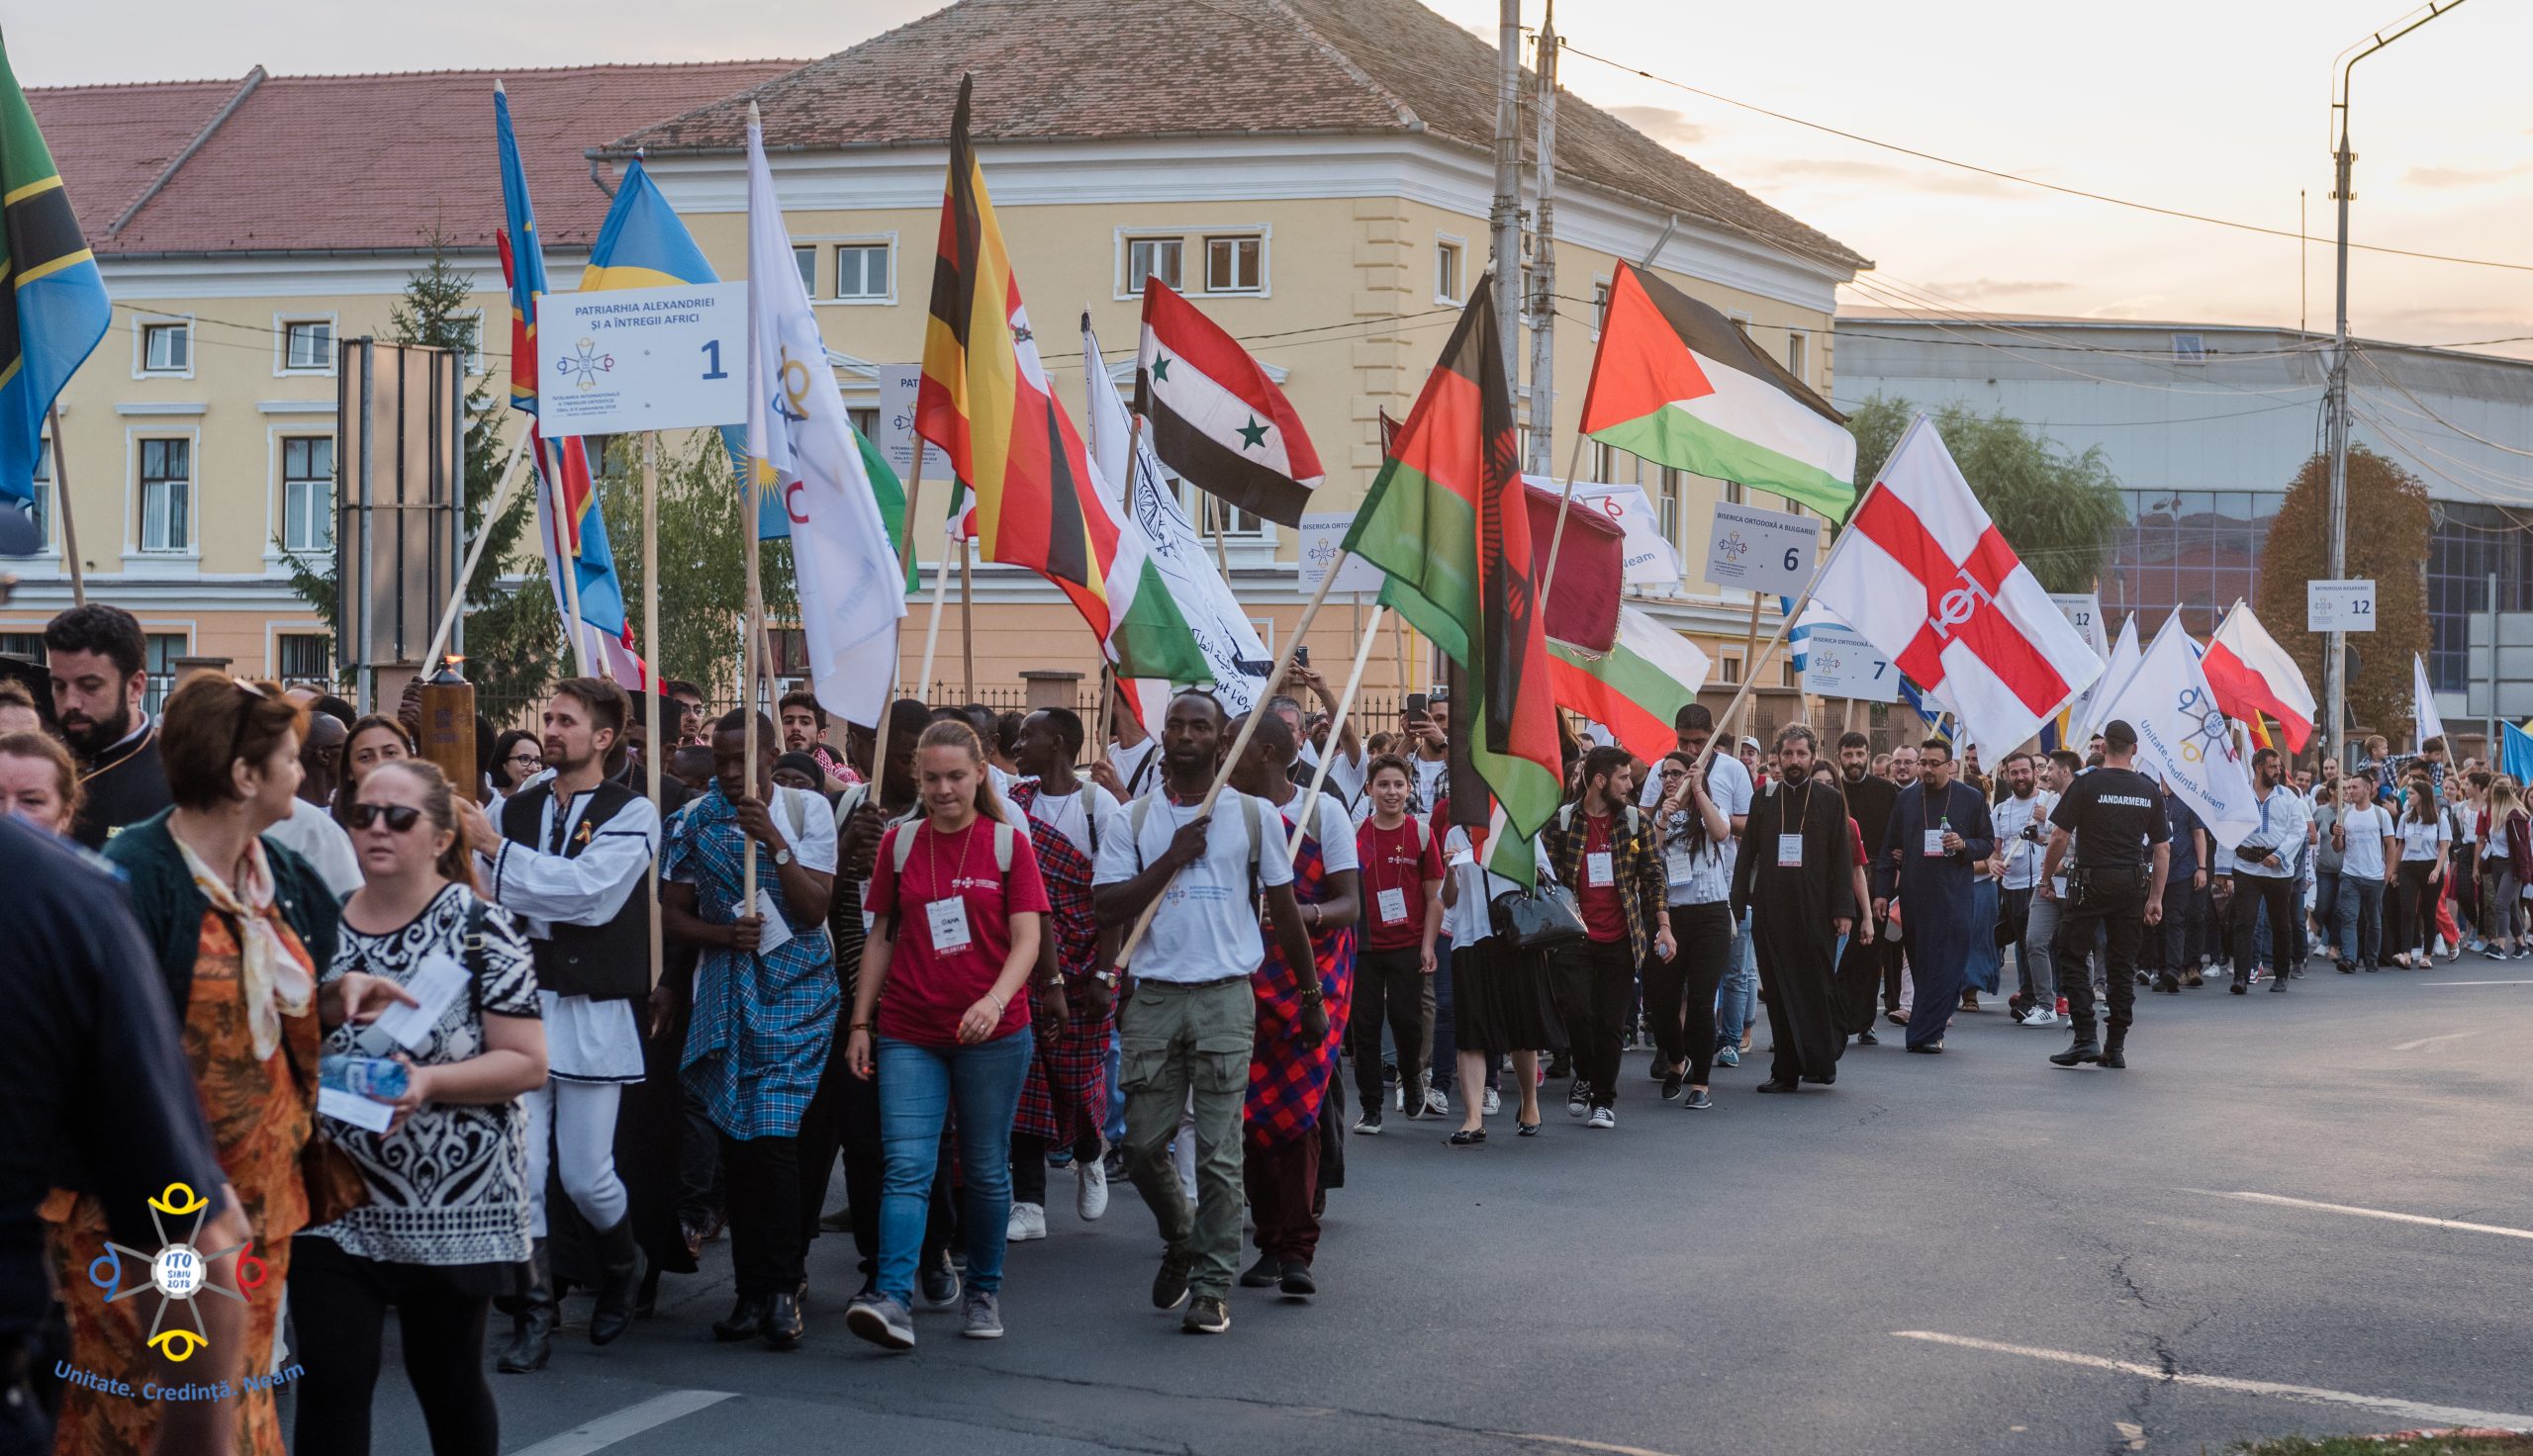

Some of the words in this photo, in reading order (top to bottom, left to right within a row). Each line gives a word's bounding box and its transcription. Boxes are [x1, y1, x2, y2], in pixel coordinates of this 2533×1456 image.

[575, 303, 640, 316] PATRIARHIA
[642, 298, 714, 312] ALEXANDRIEI
[604, 318, 611, 328] A
[613, 316, 661, 327] ÎNTREGII
[664, 314, 700, 324] AFRICI
[701, 339, 728, 380] 1
[1717, 512, 1743, 523] BISERICA
[1744, 518, 1778, 528] ORTODOXĂ
[1784, 524, 1816, 536] BULGARIEI
[1783, 547, 1799, 572] 6
[2352, 599, 2371, 614] 12
[2076, 612, 2090, 626] 12
[1873, 661, 1887, 680] 7
[2140, 719, 2168, 760] Unitate.
[2167, 758, 2199, 794] Credință.
[2201, 789, 2225, 811] Neam
[2098, 794, 2152, 808] JANDARMERIA
